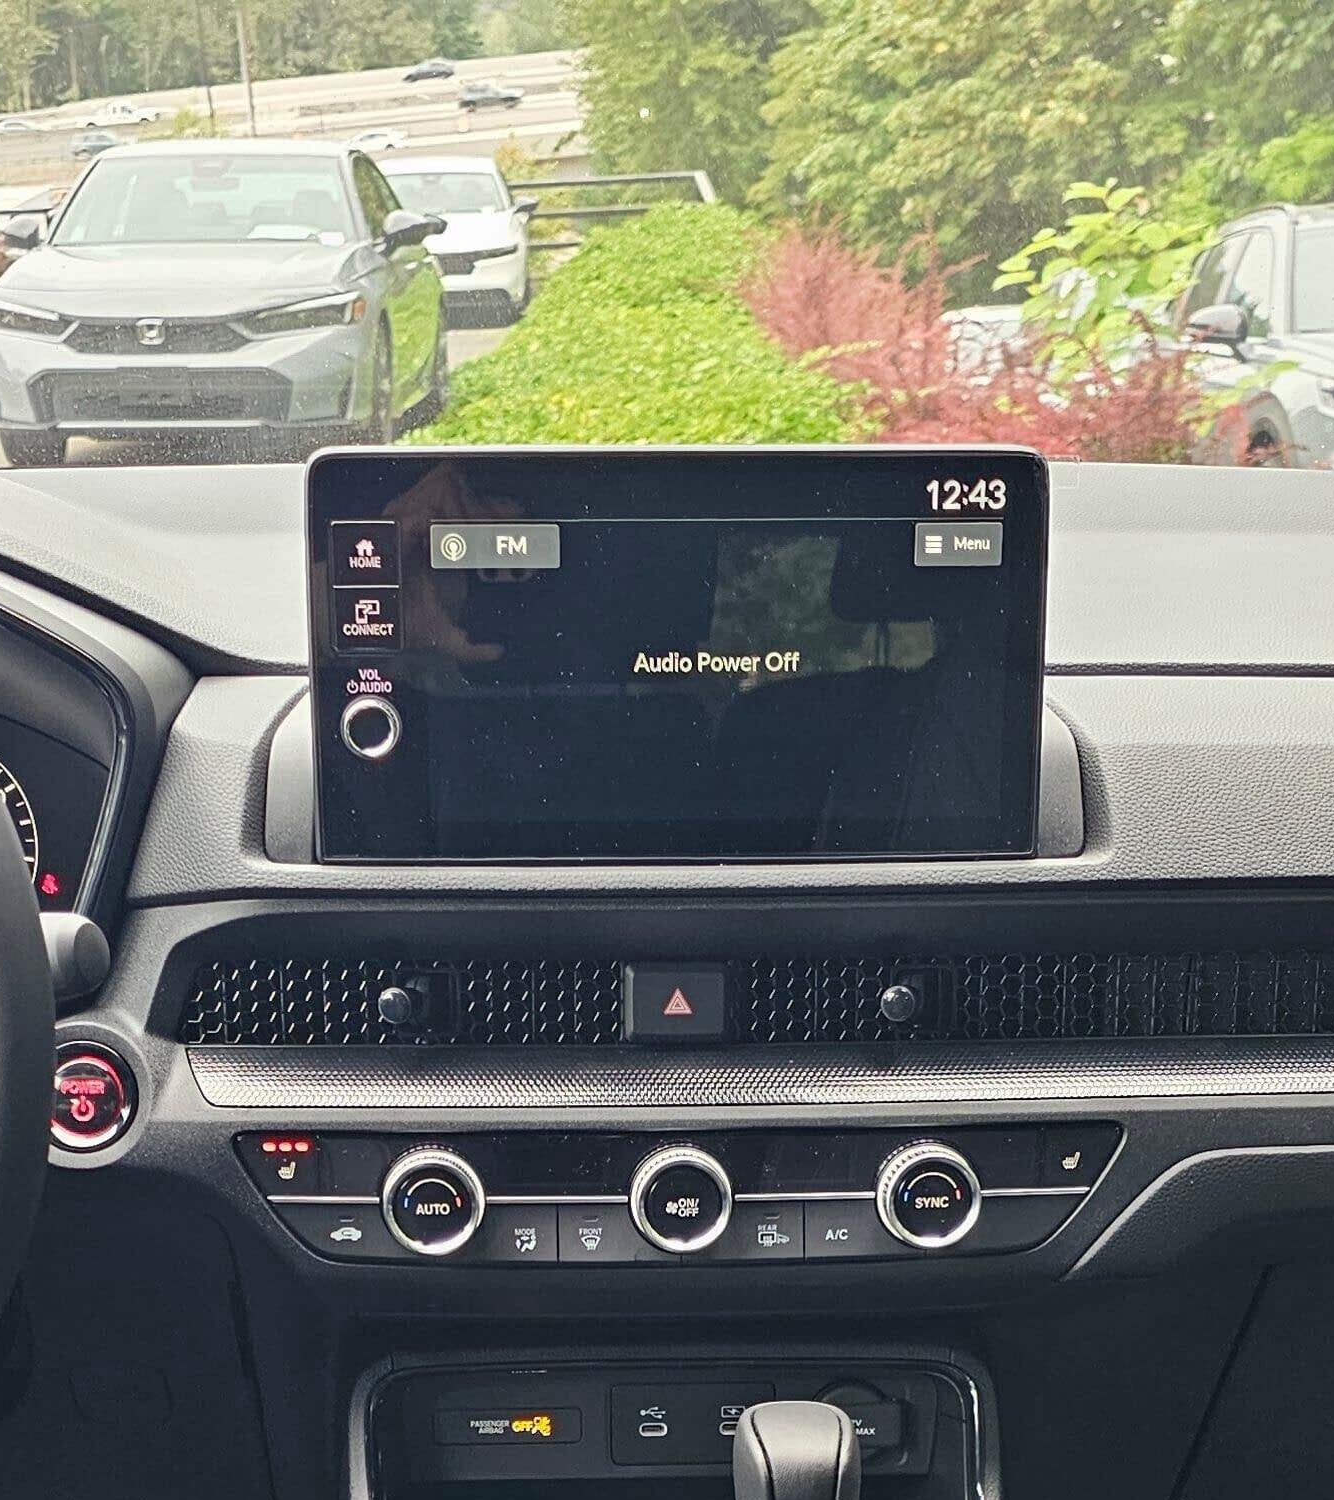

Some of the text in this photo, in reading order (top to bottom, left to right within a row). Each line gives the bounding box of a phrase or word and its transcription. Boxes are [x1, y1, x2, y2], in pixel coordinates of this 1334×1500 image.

[926, 479, 1007, 510] 12:43
[496, 535, 527, 555] FM
[954, 536, 991, 551] Menu
[349, 556, 382, 569] HOME
[342, 623, 394, 636] CONNECT
[633, 652, 801, 673] Audio Power Off
[358, 668, 381, 681] VOL
[359, 681, 393, 693] AUDIO
[60, 1079, 105, 1095] POWER
[678, 1197, 700, 1208] ON/
[914, 1196, 950, 1210] SYNC
[415, 1203, 451, 1216] AUTO
[678, 1208, 700, 1218] OFF
[514, 1227, 536, 1236] MODE
[578, 1227, 603, 1236] FRONT
[825, 1228, 849, 1241] A/C
[470, 1420, 510, 1428] PASSENGER
[511, 1420, 533, 1433] OFF
[855, 1427, 876, 1436] MAX
